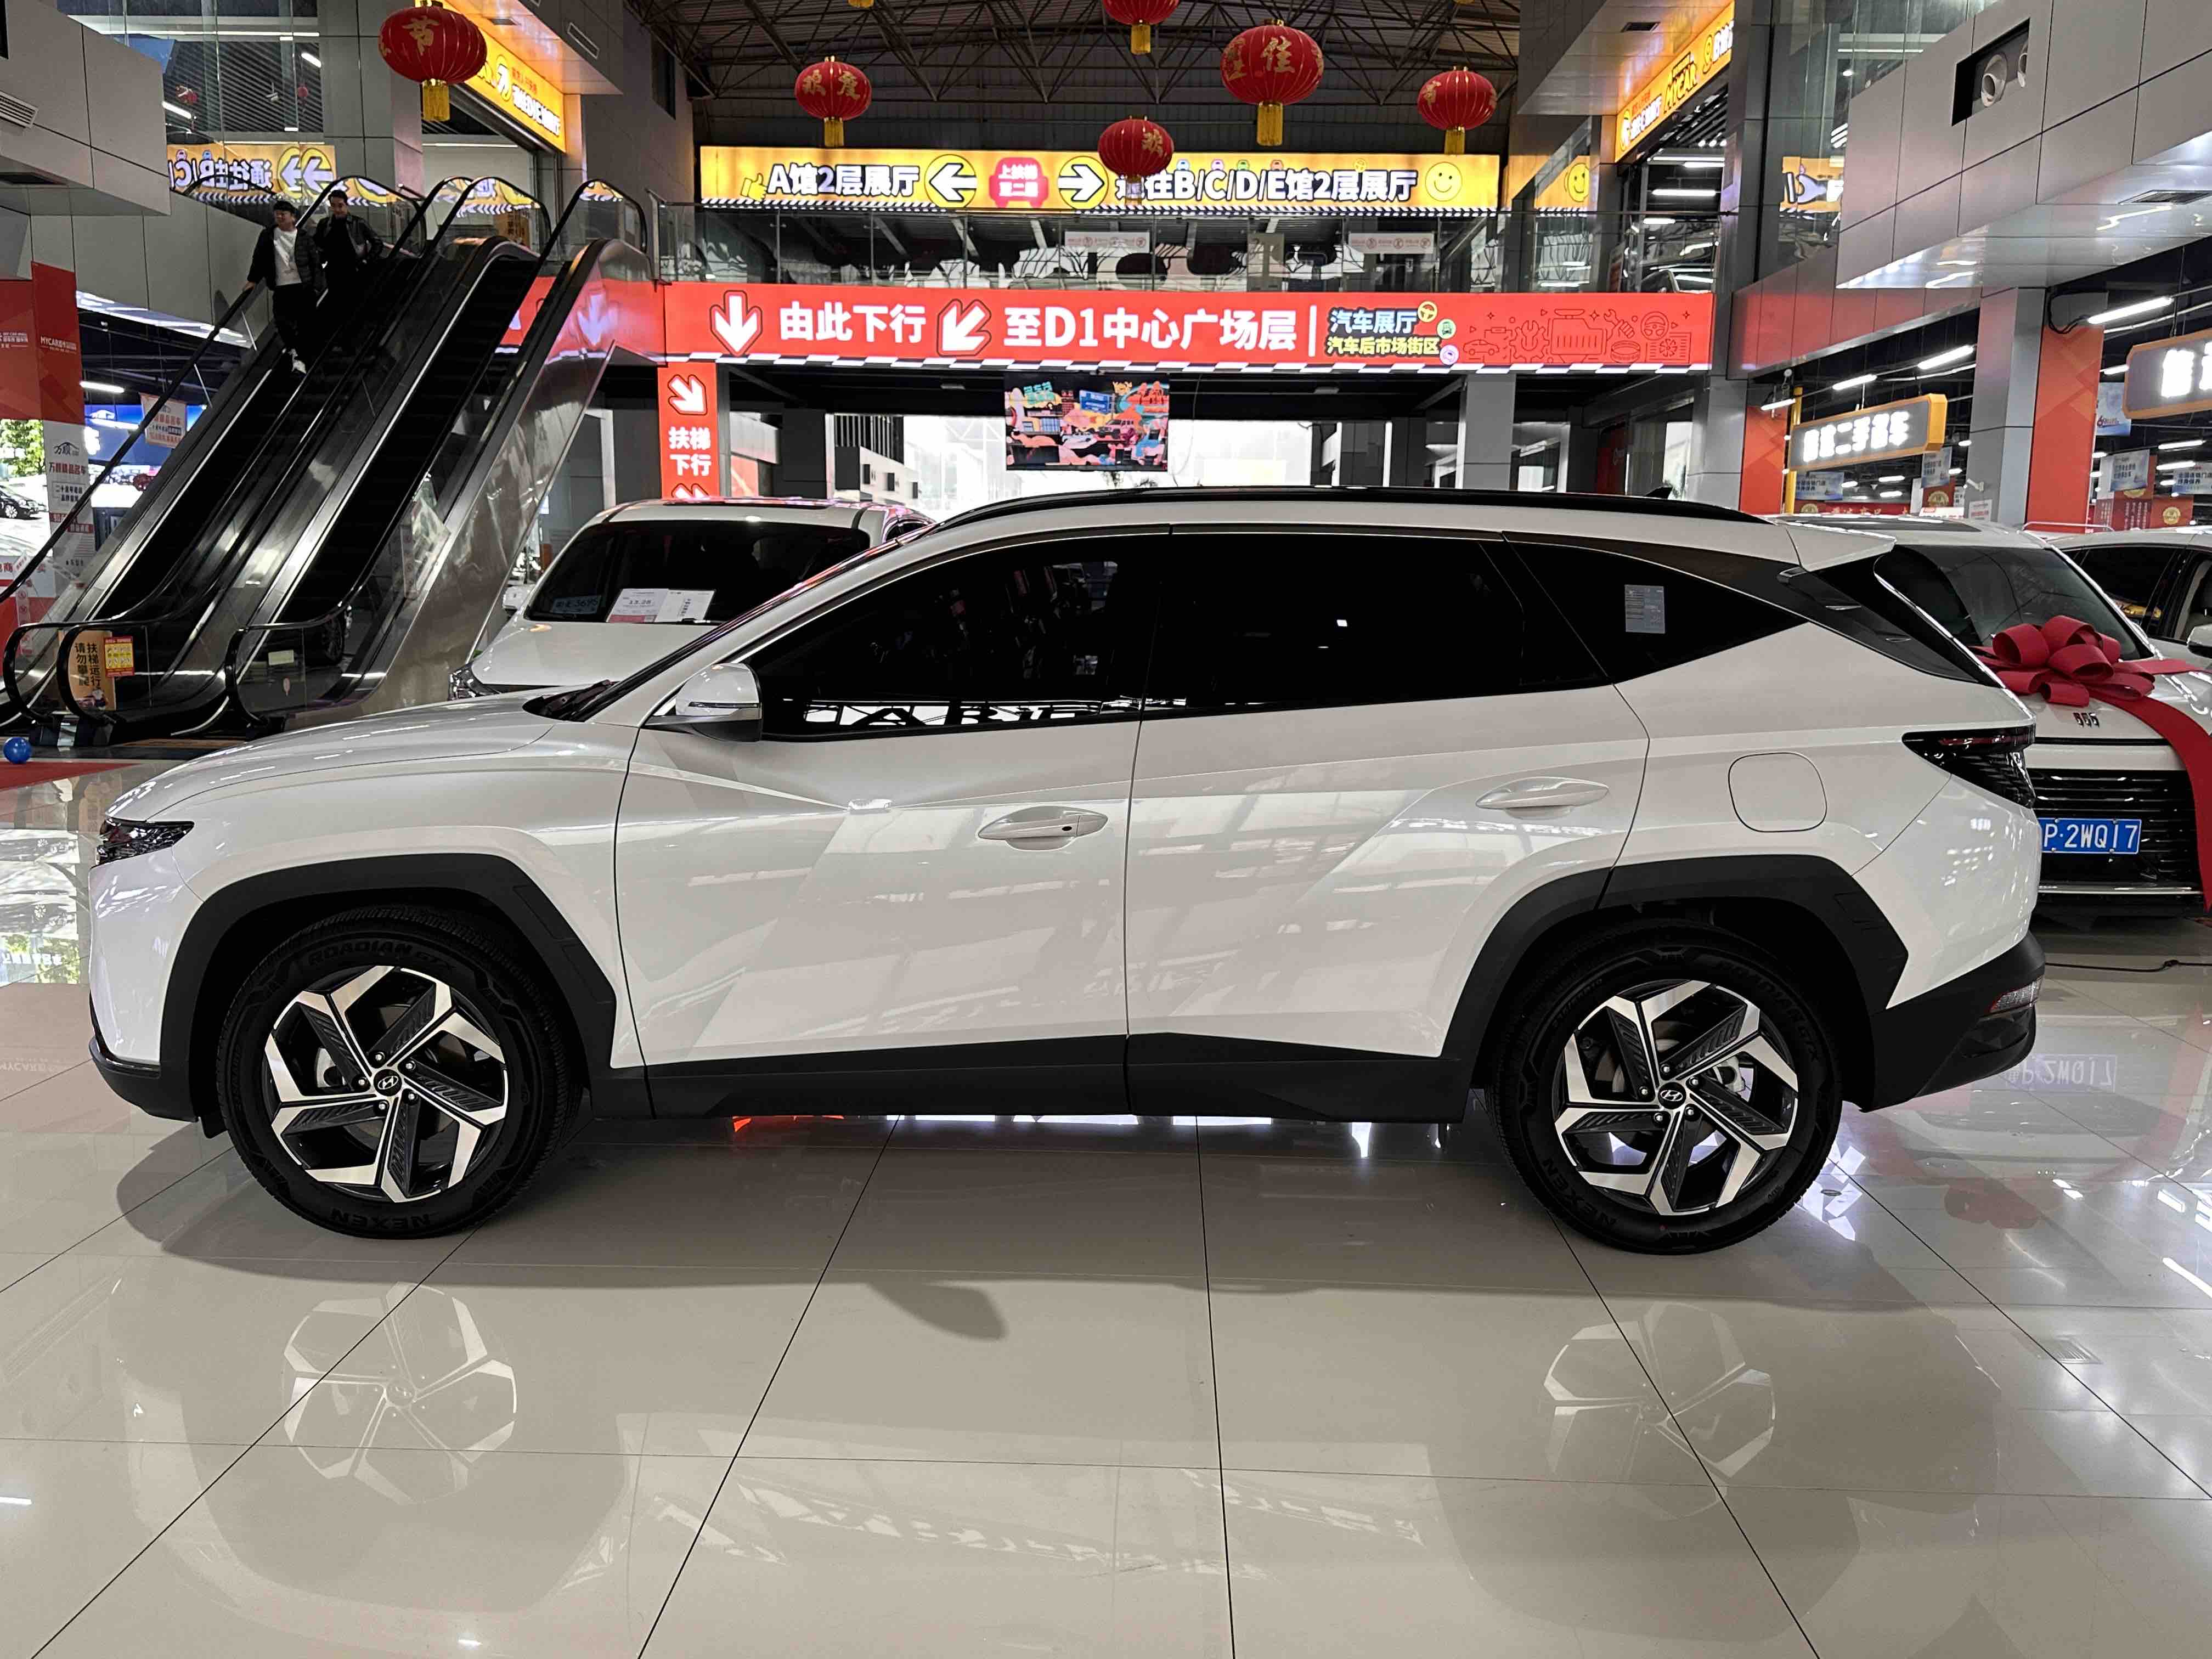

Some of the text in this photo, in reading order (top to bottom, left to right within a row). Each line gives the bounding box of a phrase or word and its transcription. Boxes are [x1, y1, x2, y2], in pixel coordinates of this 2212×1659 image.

[767, 162, 920, 197] A馆2层展厅
[780, 301, 926, 343] 由此下行
[1003, 306, 1297, 350] 至D1中心广场层
[1330, 309, 1417, 334] 汽车展厅
[1327, 336, 1440, 355] 汽车后市场街区
[669, 426, 712, 450] 扶梯
[669, 454, 712, 476] 下行
